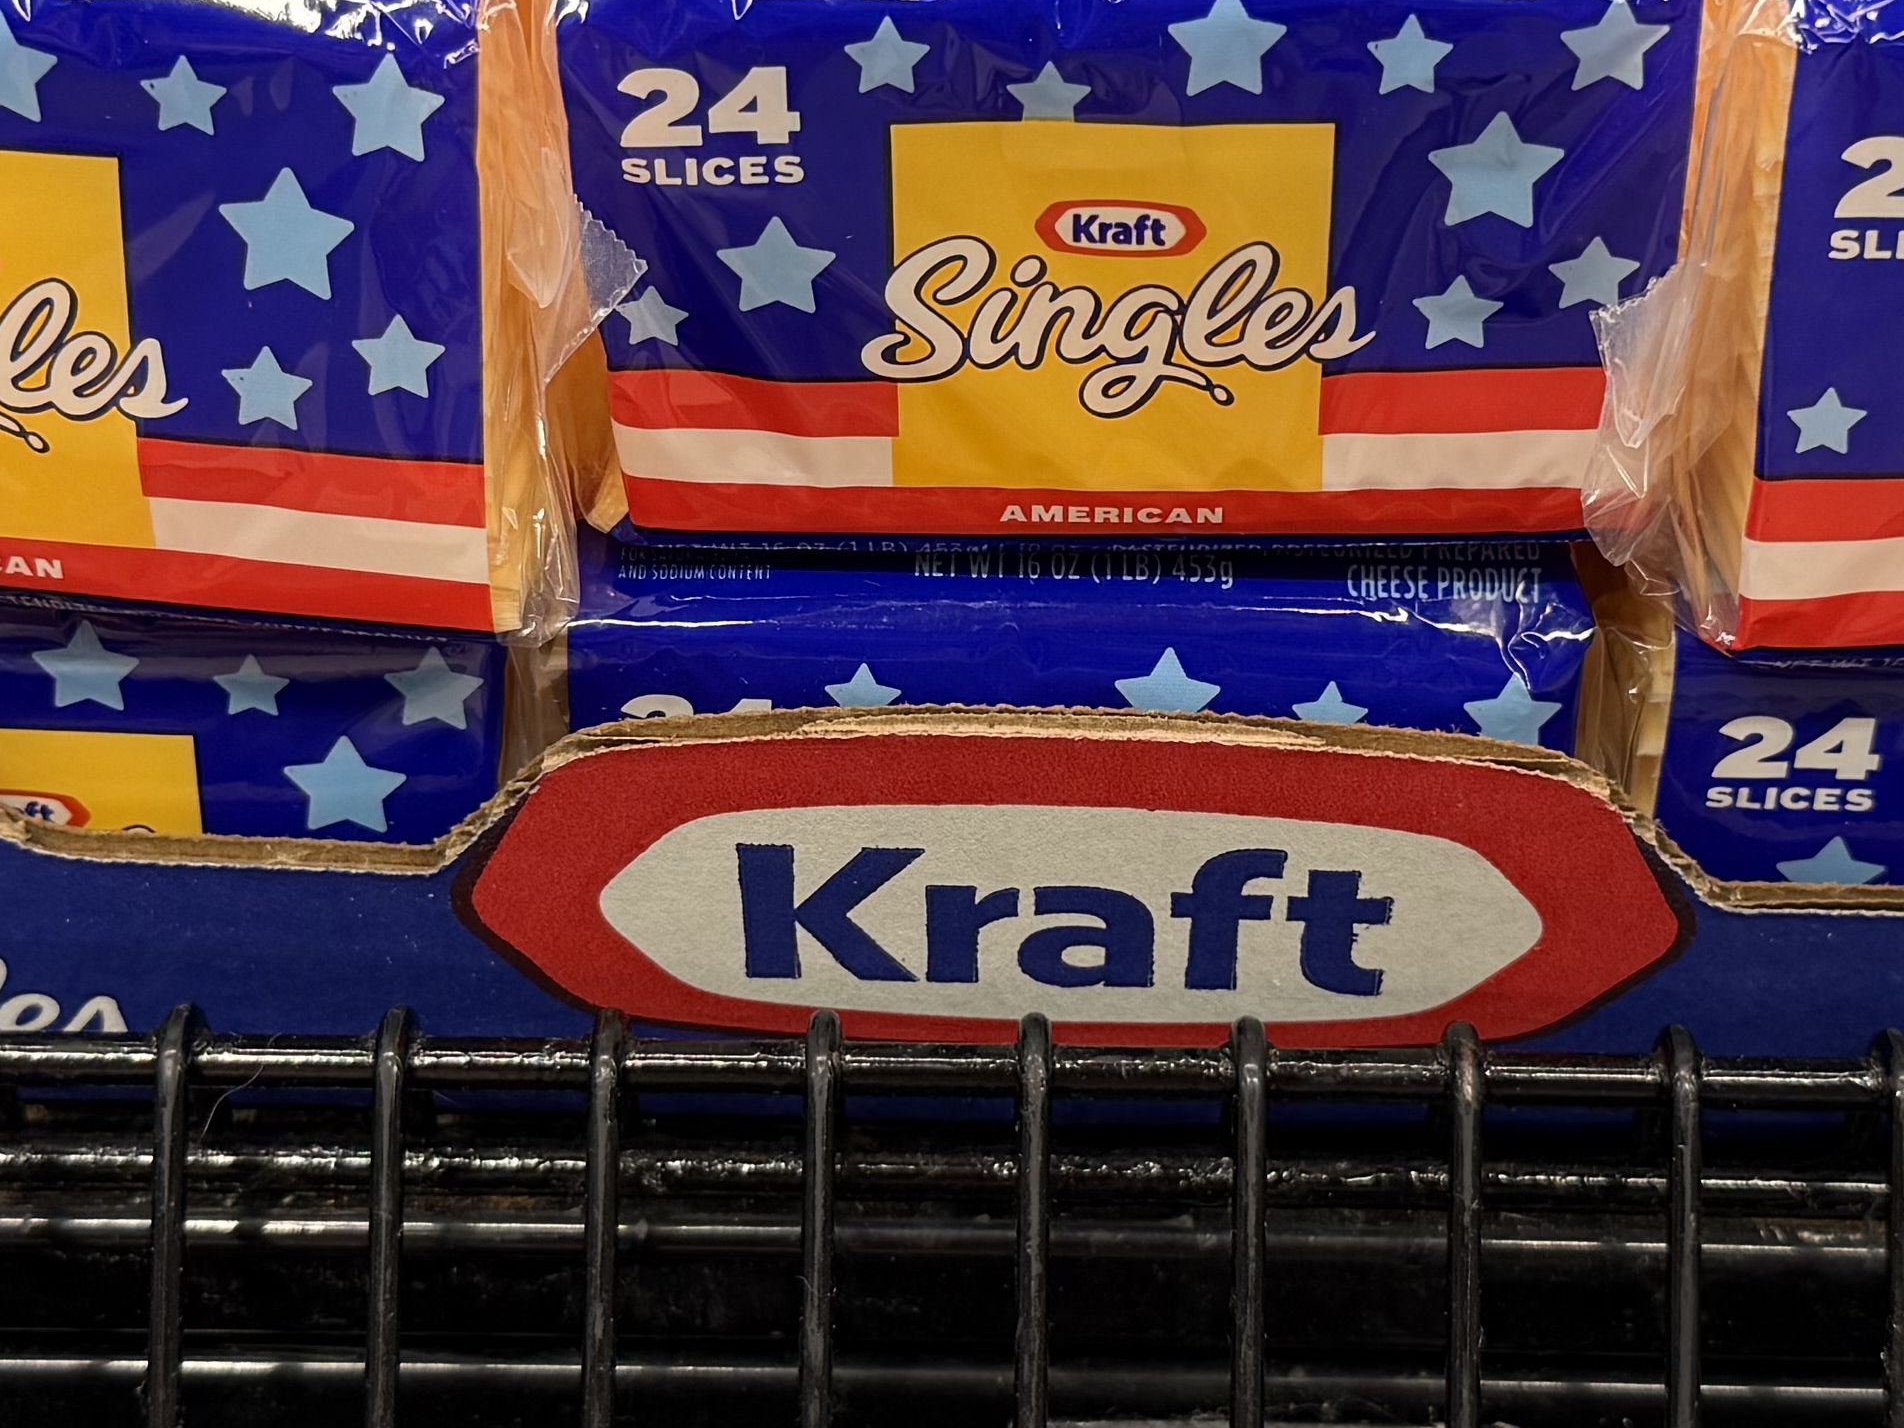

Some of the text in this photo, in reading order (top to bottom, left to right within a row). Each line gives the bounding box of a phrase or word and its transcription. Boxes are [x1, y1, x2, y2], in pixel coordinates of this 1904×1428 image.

[616, 66, 804, 149] 24
[620, 154, 805, 187] SLICES
[1070, 212, 1166, 250] Kraft
[861, 234, 1377, 419] Singles
[998, 503, 1226, 526] AMERICAN
[618, 563, 772, 581] AND SODIUM CONTENT
[914, 552, 956, 578] NET
[1018, 552, 1041, 580] 16
[1051, 552, 1081, 581] OZ
[1172, 552, 1234, 590] 453g
[1347, 564, 1542, 604] CHEESE PRODUCT
[1712, 715, 1881, 780] 24
[1705, 785, 1874, 813] SLICES
[736, 843, 1393, 996] Kraft
